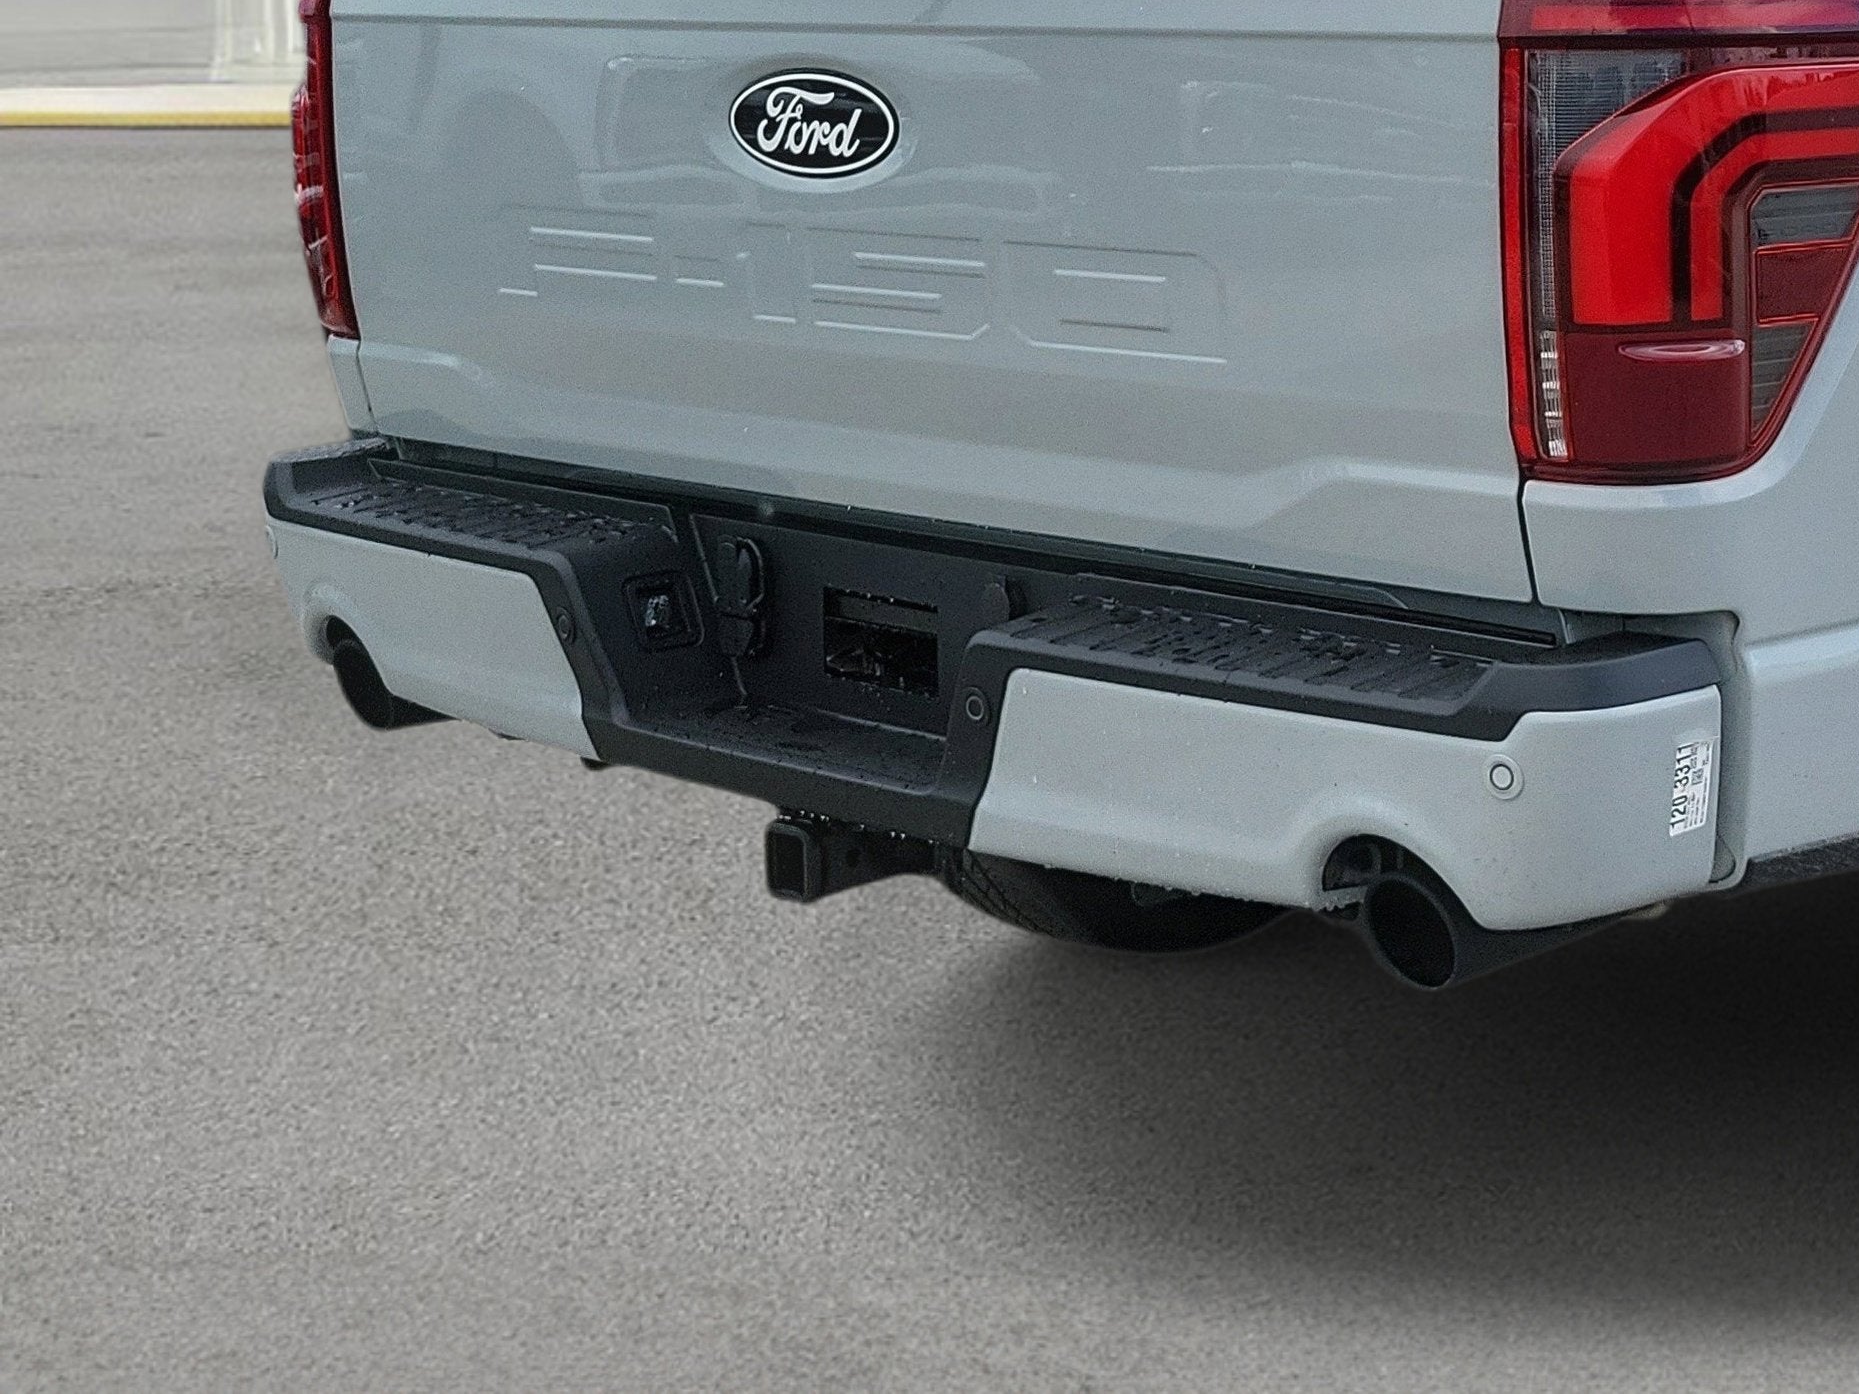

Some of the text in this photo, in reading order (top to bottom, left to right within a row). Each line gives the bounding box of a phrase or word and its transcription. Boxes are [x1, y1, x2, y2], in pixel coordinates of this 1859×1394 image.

[757, 86, 862, 158] Ford
[1669, 742, 1698, 829] 120 3311
